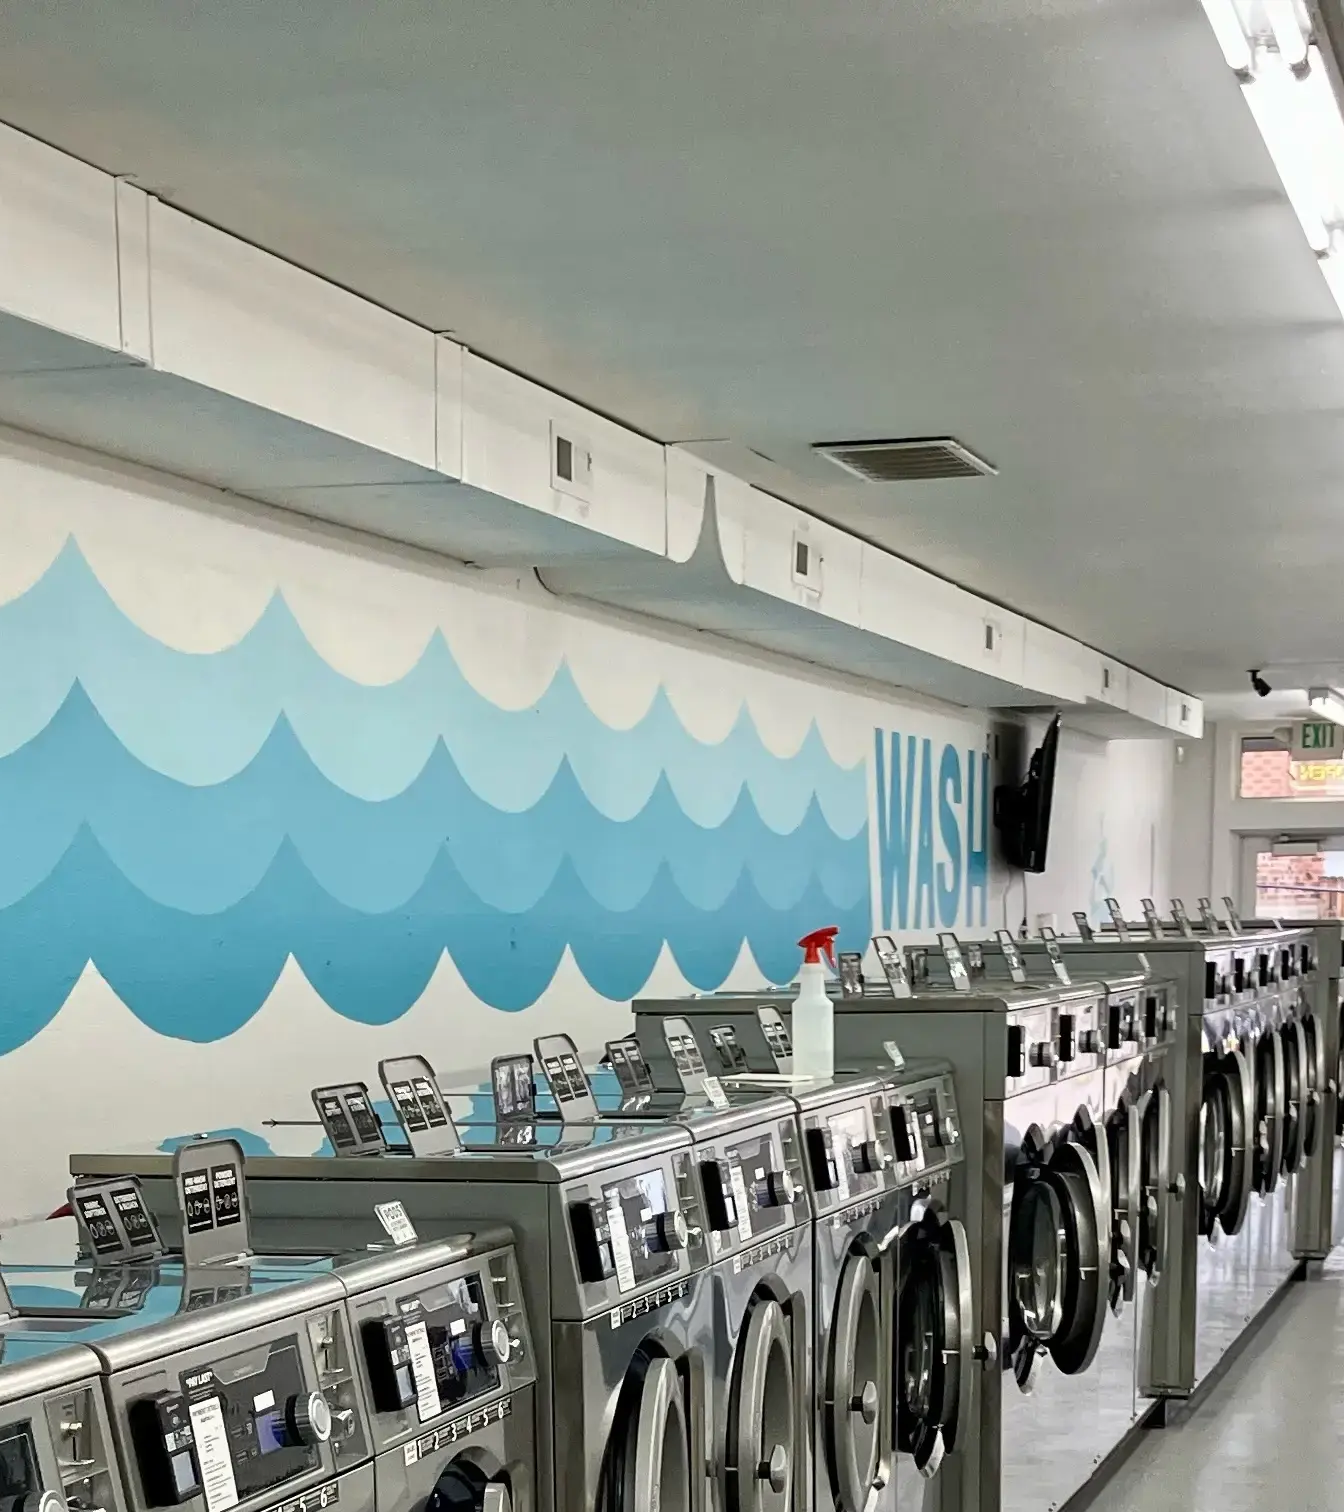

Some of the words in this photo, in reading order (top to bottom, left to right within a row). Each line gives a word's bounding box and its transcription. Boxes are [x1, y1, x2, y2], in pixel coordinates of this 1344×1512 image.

[1301, 722, 1335, 749] EXIT
[873, 726, 989, 931] WASH
[320, 1487, 328, 1508] 6
